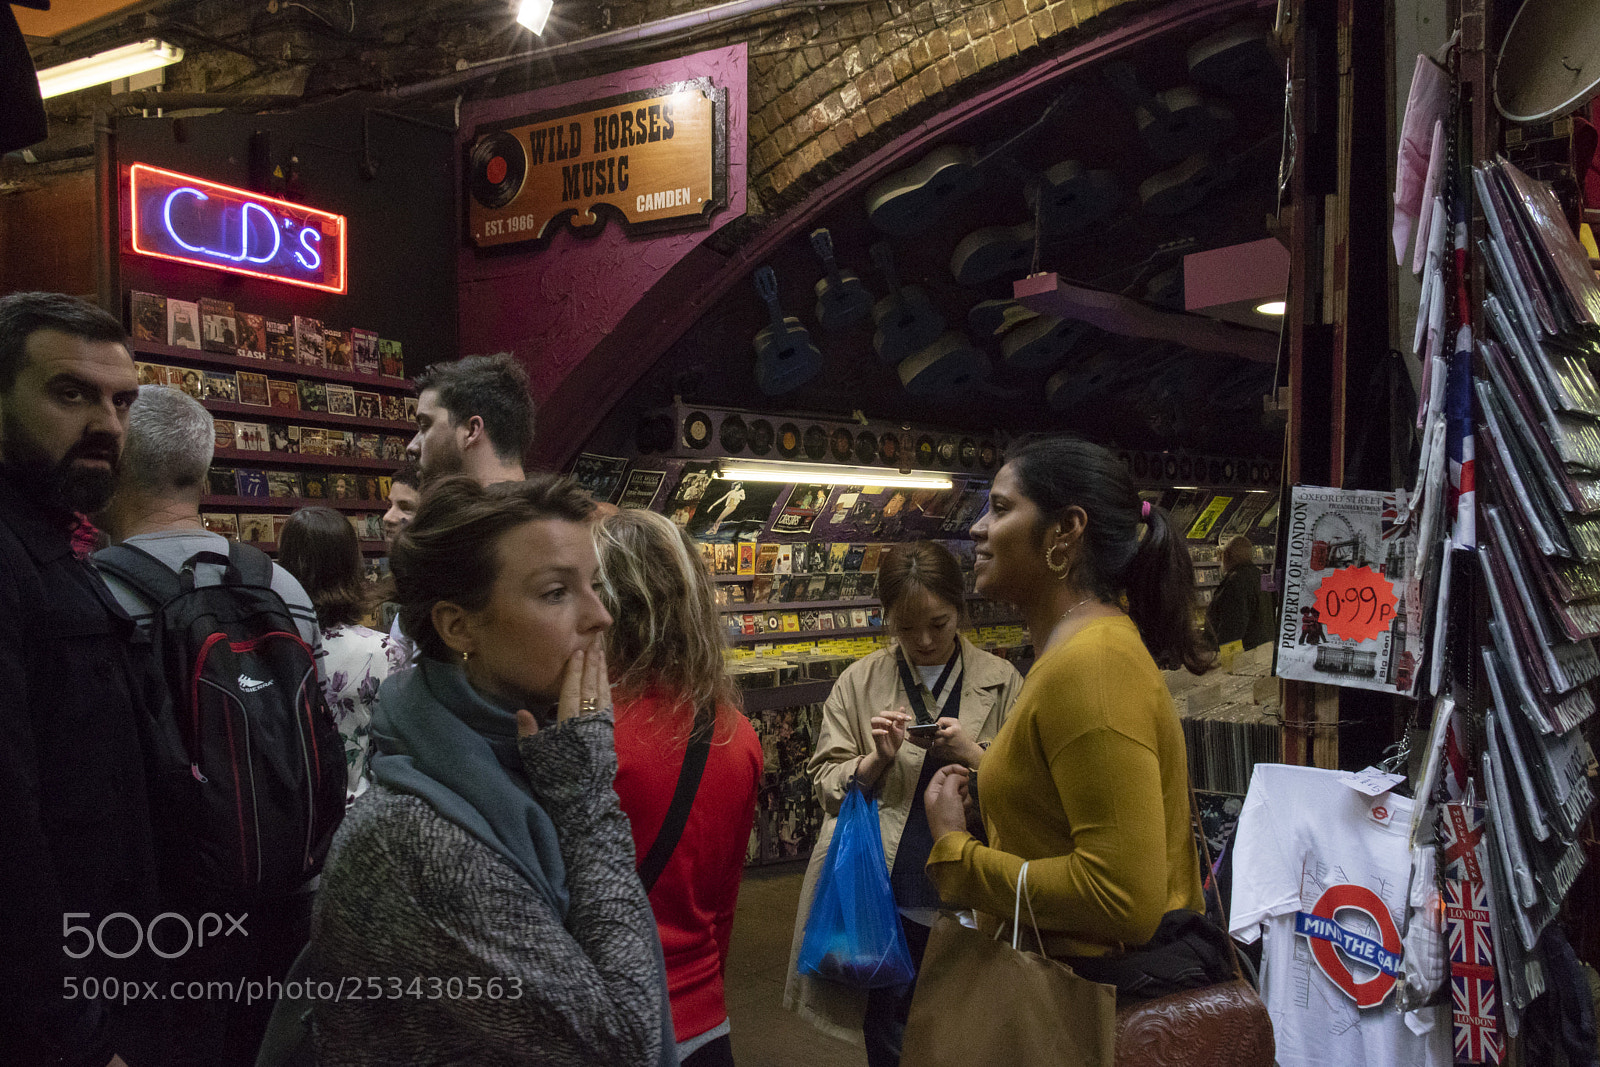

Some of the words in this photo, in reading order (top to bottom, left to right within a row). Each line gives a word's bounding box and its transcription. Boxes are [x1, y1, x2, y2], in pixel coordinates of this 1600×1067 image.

[529, 122, 582, 166] WILD
[593, 102, 675, 154] HORSES
[561, 155, 629, 202] MUSIC
[636, 187, 691, 213] CAMDEN
[485, 219, 505, 237] EST.
[507, 214, 534, 234] 1986
[1300, 492, 1343, 503] OXFORD
[1346, 495, 1382, 505] STREET
[1290, 502, 1308, 557] LONDON
[1288, 560, 1302, 578] OF
[1282, 580, 1300, 650] PROPERTY
[1561, 775, 1596, 833] LAWYER
[1452, 810, 1467, 844] MONEY
[1466, 851, 1478, 878] BANK
[1450, 909, 1487, 921] LONDON
[1304, 917, 1343, 942] MIND
[1344, 933, 1376, 960] THE
[1456, 1013, 1494, 1027] LONDON
